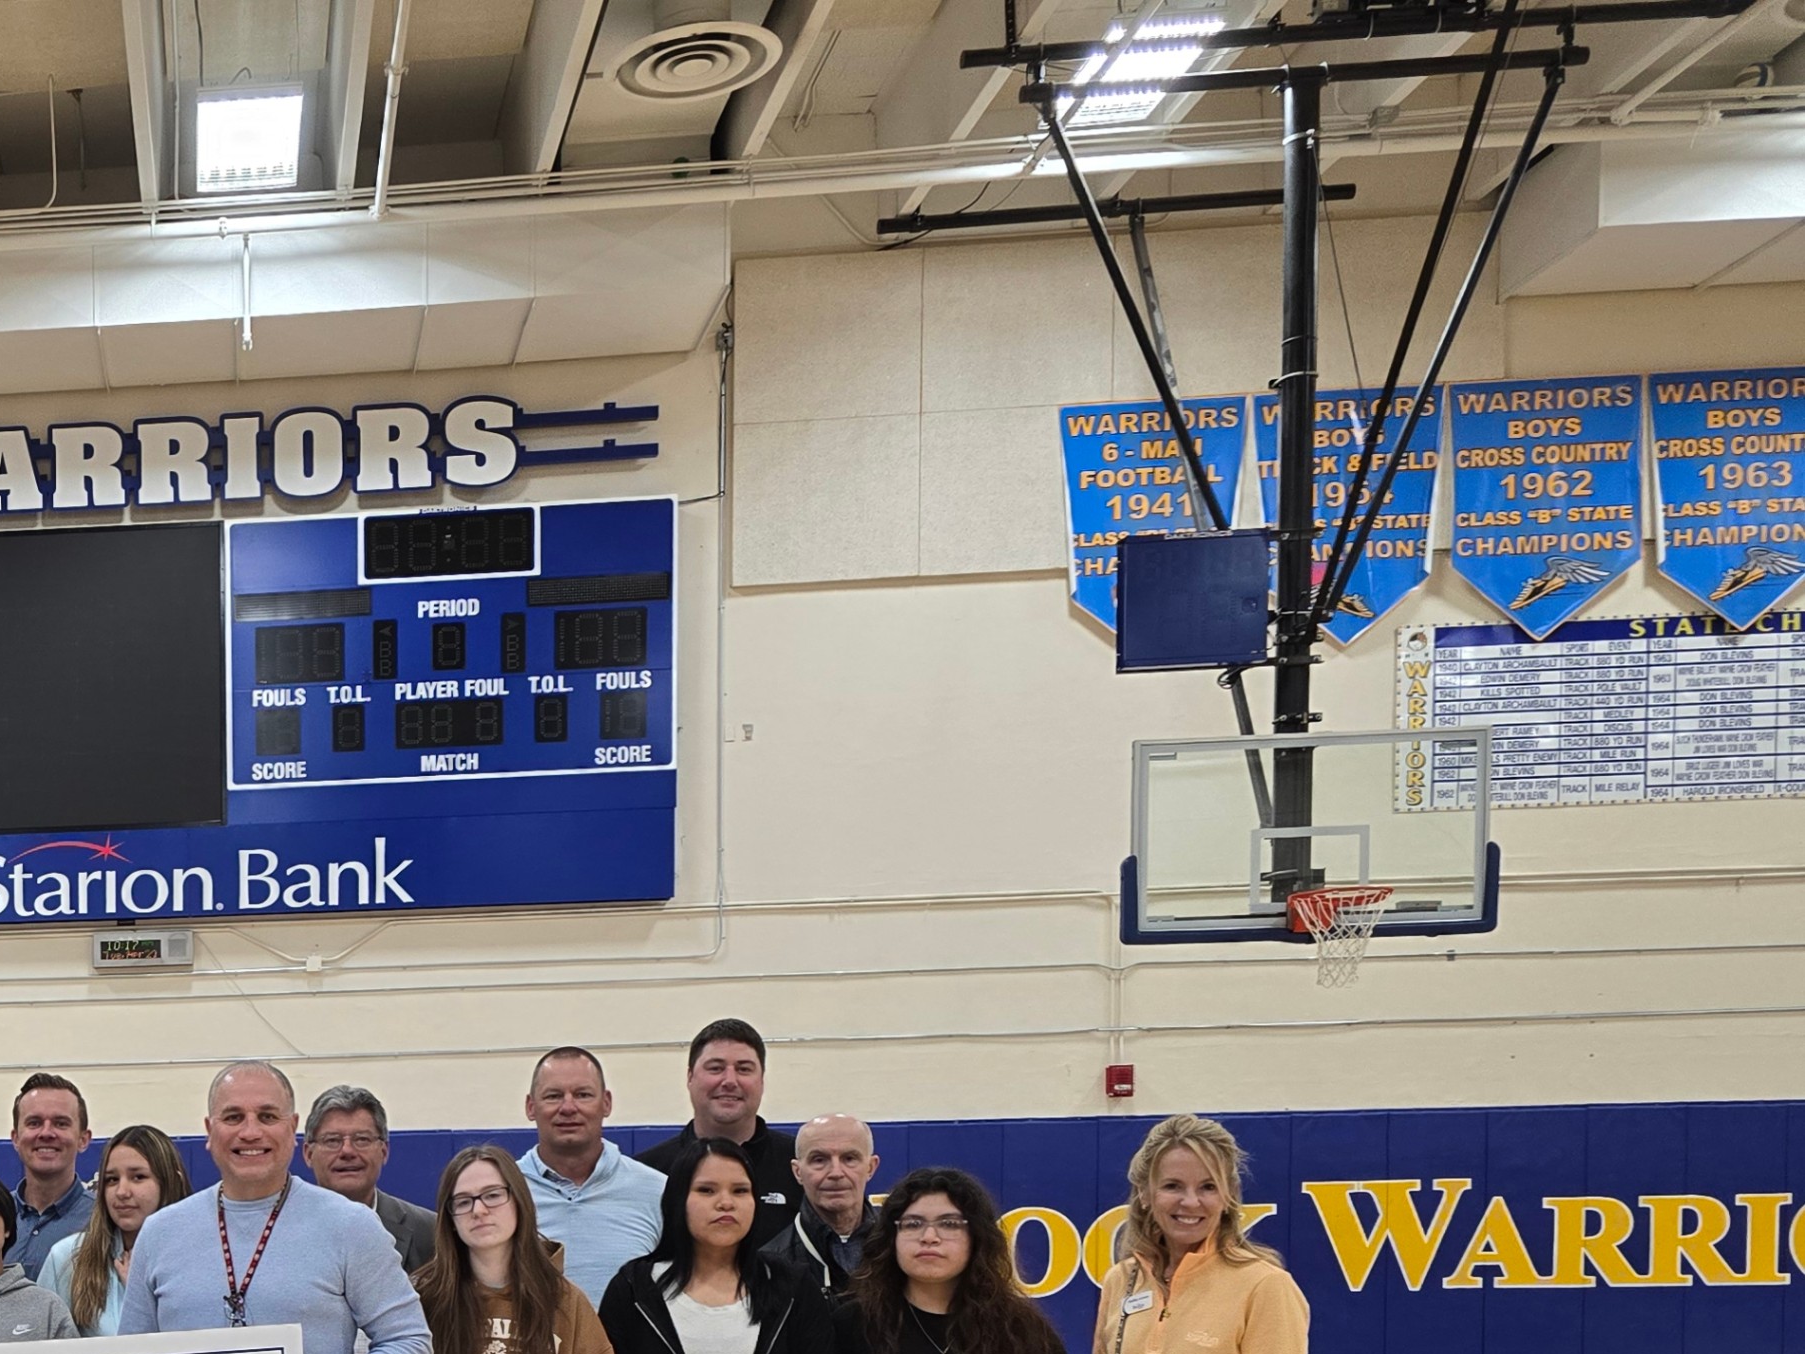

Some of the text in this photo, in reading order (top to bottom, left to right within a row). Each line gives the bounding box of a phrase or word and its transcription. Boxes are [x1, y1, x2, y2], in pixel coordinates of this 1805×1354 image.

[1457, 385, 1633, 415] WARRIORS
[1262, 396, 1436, 426] WRRIORS
[1706, 408, 1781, 429] BOYS
[1508, 418, 1582, 439] BOYS
[1102, 443, 1119, 461] 6
[1456, 442, 1632, 469] CROSS COUNTRY
[1655, 437, 1726, 458] CROSS
[1080, 464, 1224, 489] FOOTBAL
[1499, 470, 1594, 500] 1962
[1698, 461, 1793, 490] 1963
[1106, 492, 1193, 520] 1941
[1456, 509, 1521, 527] CLASS
[1567, 505, 1634, 521] STATE
[1456, 530, 1633, 557] CHAMPIONS
[418, 599, 480, 619] PERIOD
[1438, 649, 1458, 659] YEAR
[1608, 640, 1632, 651] EVENT
[1463, 661, 1499, 671] CLAYTON
[1502, 658, 1558, 669] ARCHAMBAULT
[1564, 657, 1590, 667] TRACK
[1480, 675, 1506, 684] EDWIN
[1508, 673, 1540, 683] DEMERY
[1564, 670, 1590, 680] TRACK
[252, 671, 652, 707] FOULS T.O.L. PLAYER FOUL T.O.L. FOULS
[1438, 681, 1643, 700] 1942 KILLS SPOTTED TRACK POLE VAULT
[1720, 691, 1753, 701] BLEVINS
[1462, 701, 1499, 712] CLAYTON
[1500, 698, 1557, 710] ARCHAMBAULT
[1563, 697, 1589, 708] TRACK
[1720, 704, 1753, 714] BLEVINS
[1438, 710, 1635, 726] 1942 TRACK MEDLEY
[1720, 717, 1753, 728] BLEVINS
[1512, 723, 1634, 736] RAMEY TRACK DISCUS
[1507, 735, 1643, 750] DEMERY TRACK RUN
[252, 746, 651, 781] SCORE MATCH SCORE
[1503, 754, 1531, 764] PRETTY
[1532, 752, 1557, 762] ENEMY
[1563, 752, 1589, 761] TRACK
[1600, 750, 1617, 759] MILE
[1619, 748, 1636, 758] RUN
[1503, 761, 1642, 777] BLEVINS TRACK RUN
[1436, 781, 1640, 799] 1962 TRACK MILE RELAY
[1651, 785, 1765, 798] 1964 HAROLD IRONSHIELD
[238, 838, 415, 908] Bank
[1302, 1177, 1805, 1291] WARRI
